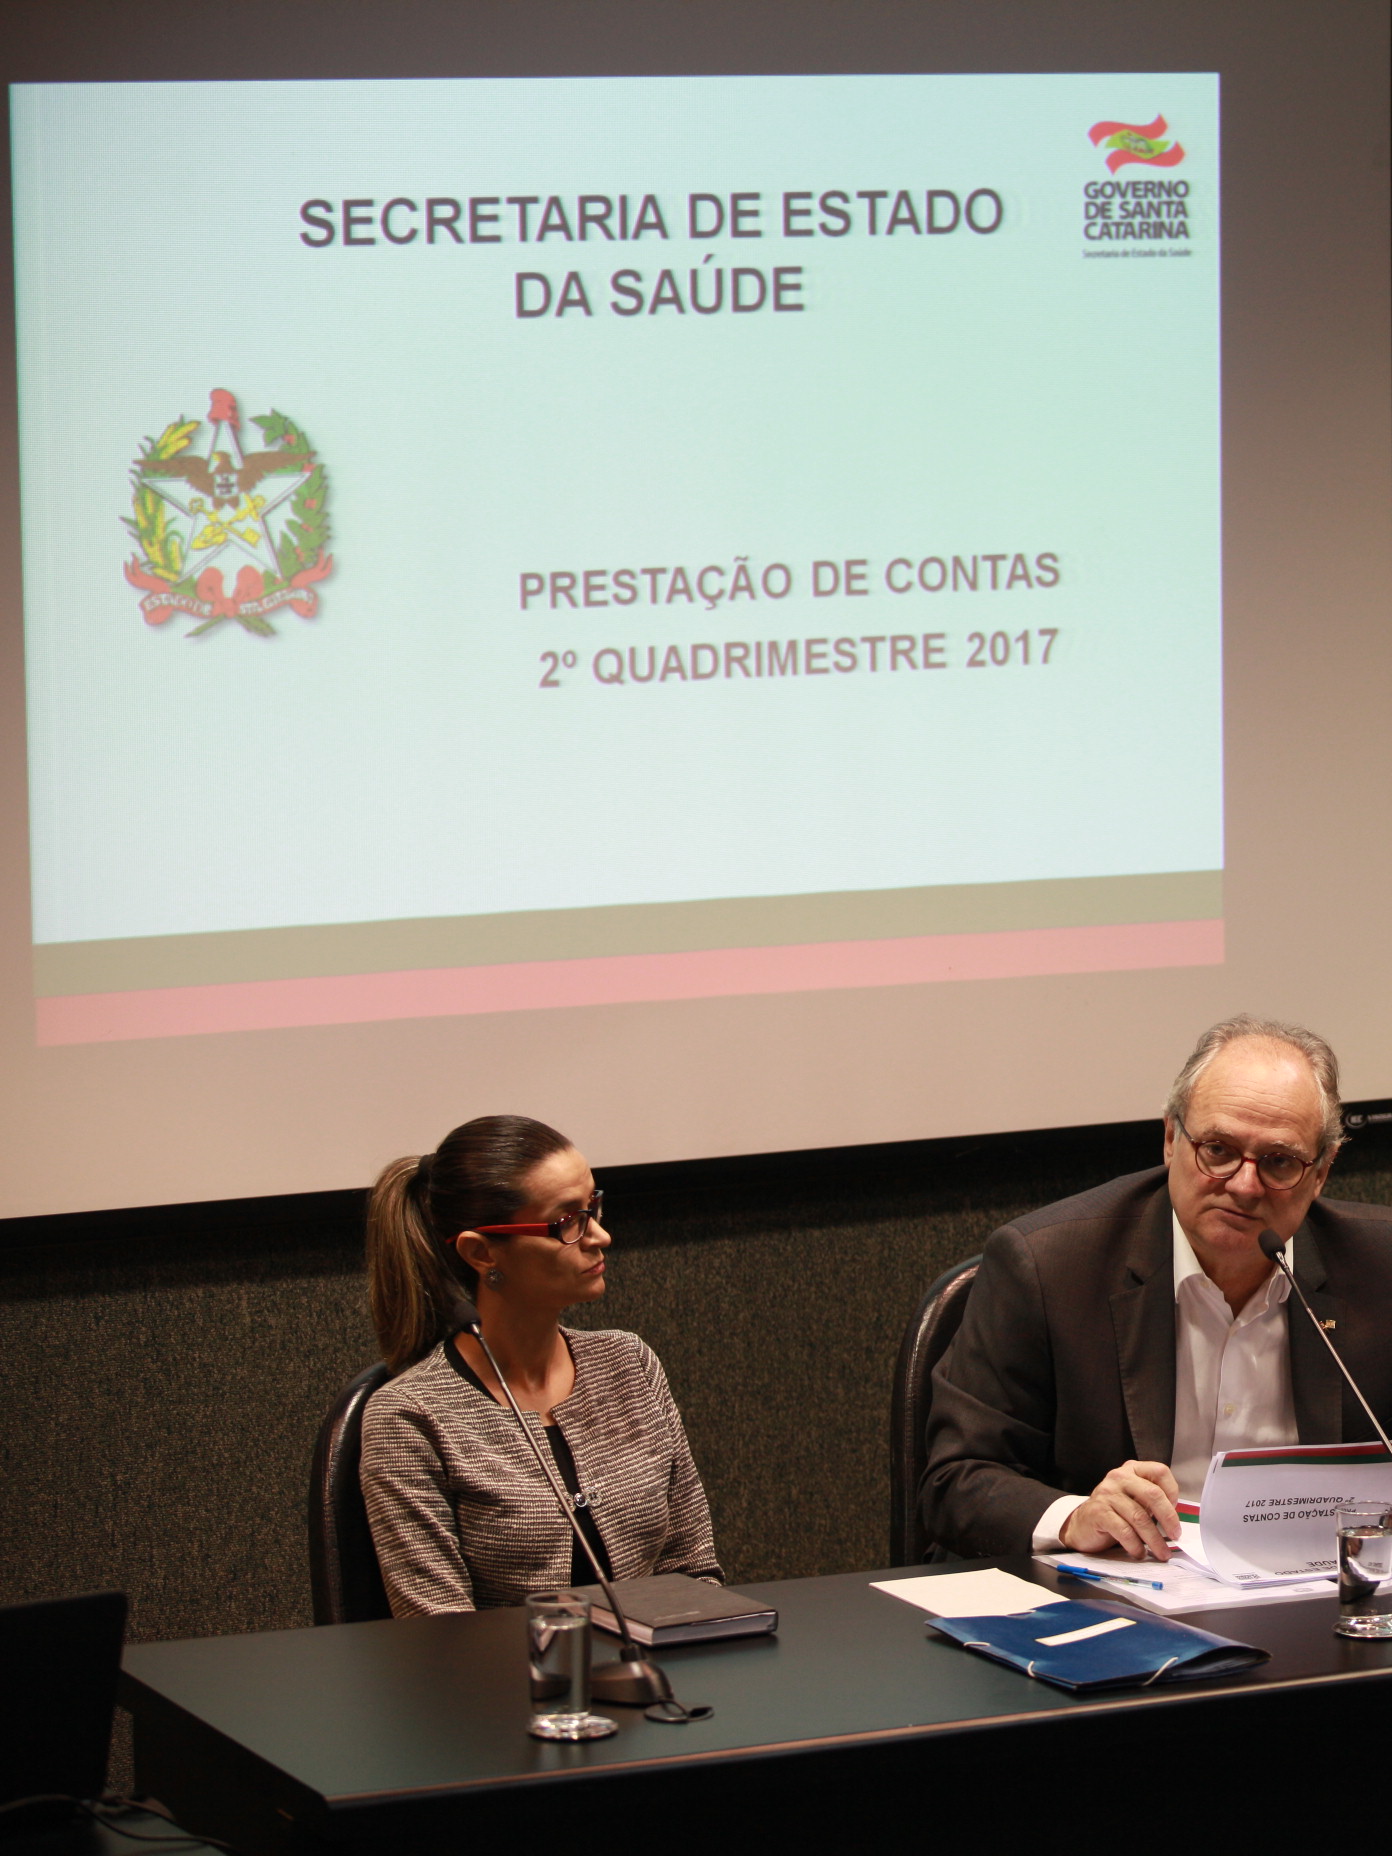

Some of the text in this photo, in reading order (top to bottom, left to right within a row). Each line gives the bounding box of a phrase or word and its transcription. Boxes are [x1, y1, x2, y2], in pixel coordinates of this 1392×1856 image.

[1083, 180, 1190, 200] GOVERNO
[299, 187, 1005, 248] SECRETARIA DE ESTADO
[1084, 200, 1189, 220] DE SANTA
[1083, 221, 1190, 241] CATARINA
[515, 253, 805, 319] DA SAÚDE
[519, 551, 1061, 611] PRESTAÇÃO DE CONTAS
[538, 627, 1060, 689] 2º QUADRIMESTRE 2017
[1245, 1499, 1266, 1507] 2017
[1268, 1496, 1344, 1506] QUADRIMESTRE
[1243, 1512, 1281, 1522] CONTAS
[1283, 1511, 1296, 1519] DE
